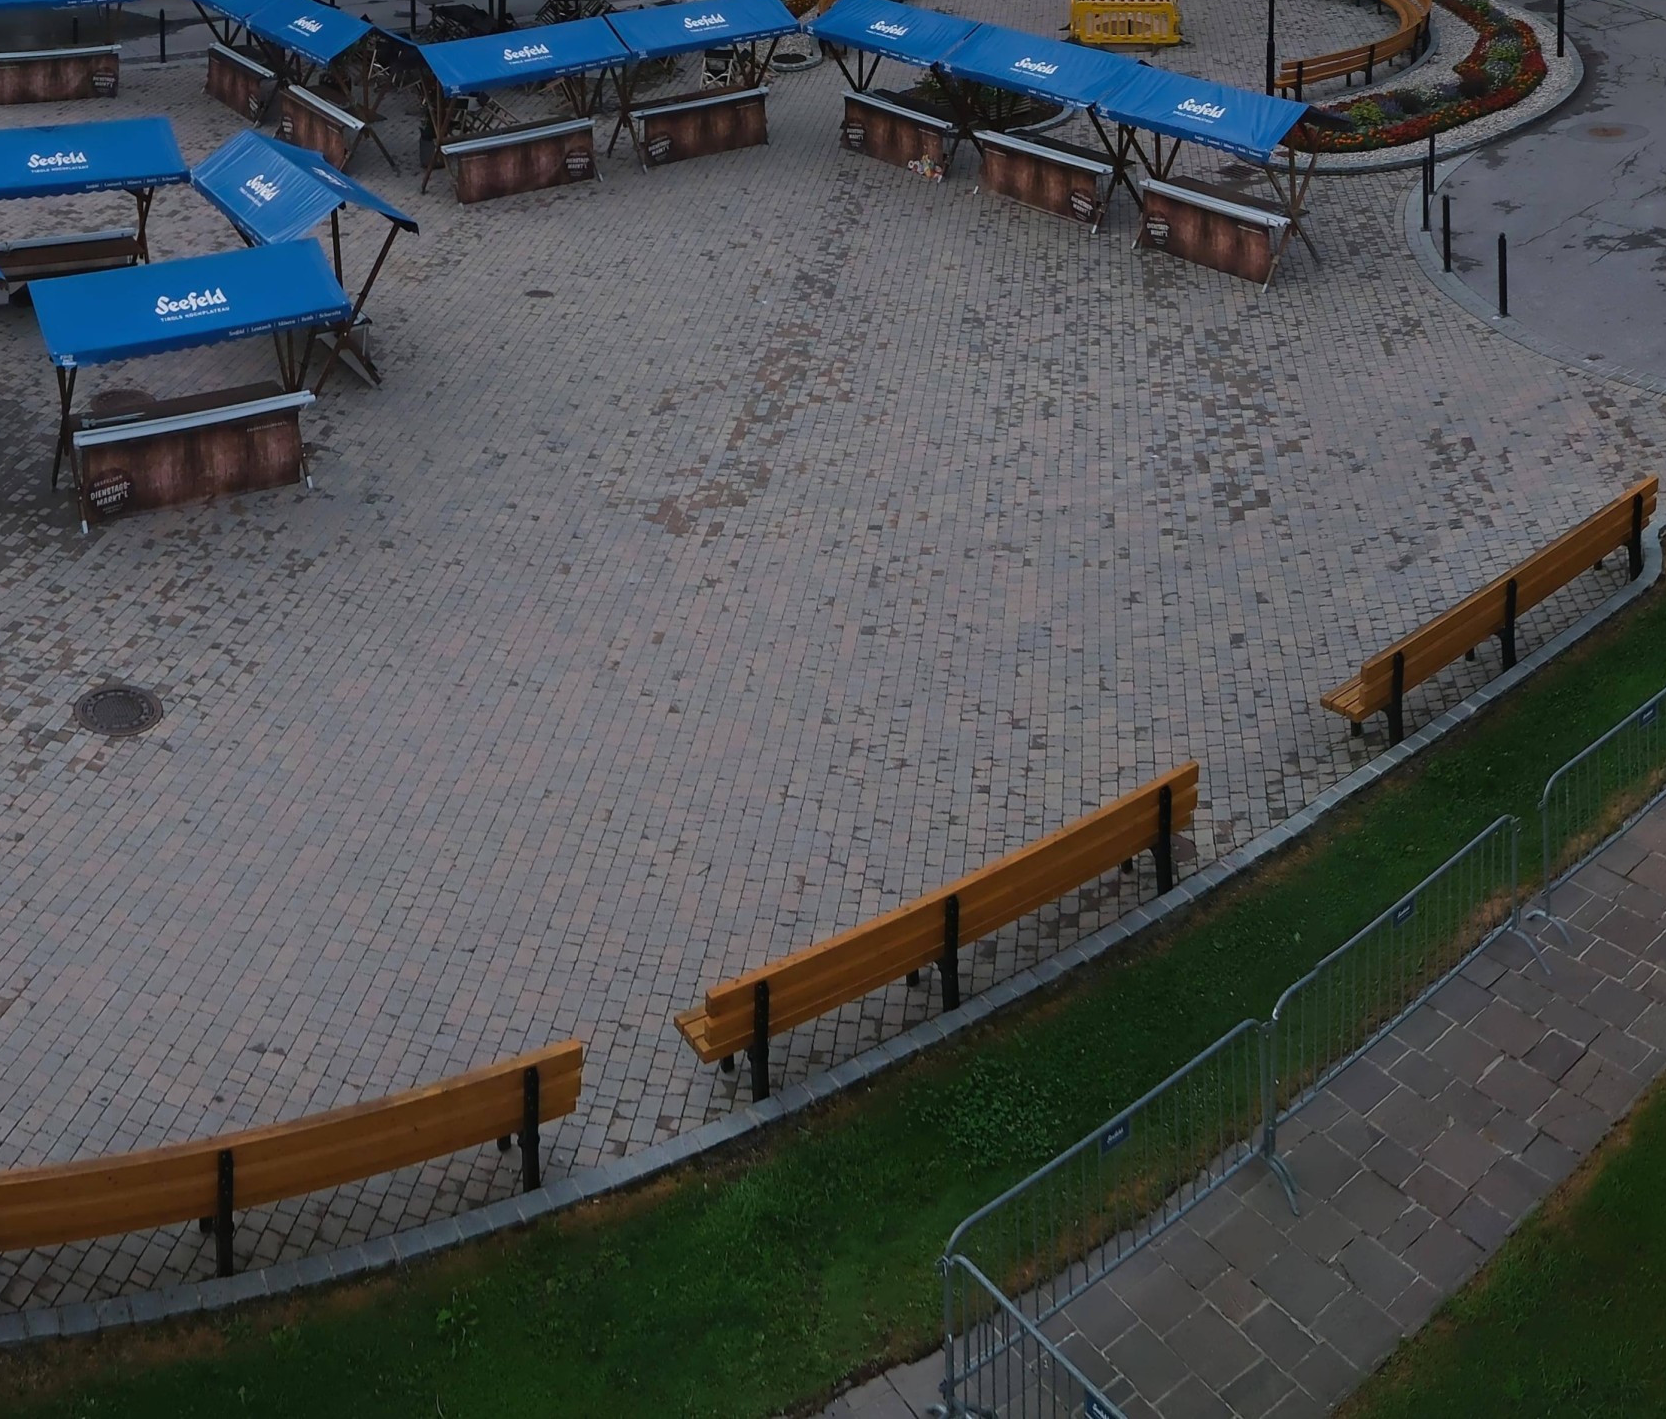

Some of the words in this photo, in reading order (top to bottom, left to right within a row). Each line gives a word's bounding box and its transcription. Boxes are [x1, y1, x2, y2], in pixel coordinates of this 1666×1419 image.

[683, 12, 727, 29] Seefeld
[869, 19, 909, 38] Seefeld
[502, 43, 550, 62] Seefeld
[1014, 56, 1059, 77] Seefeld
[1175, 97, 1227, 120] Seefeld
[26, 150, 88, 172] Seefeld
[245, 173, 279, 203] Seefeld
[154, 286, 228, 316] Seefeld
